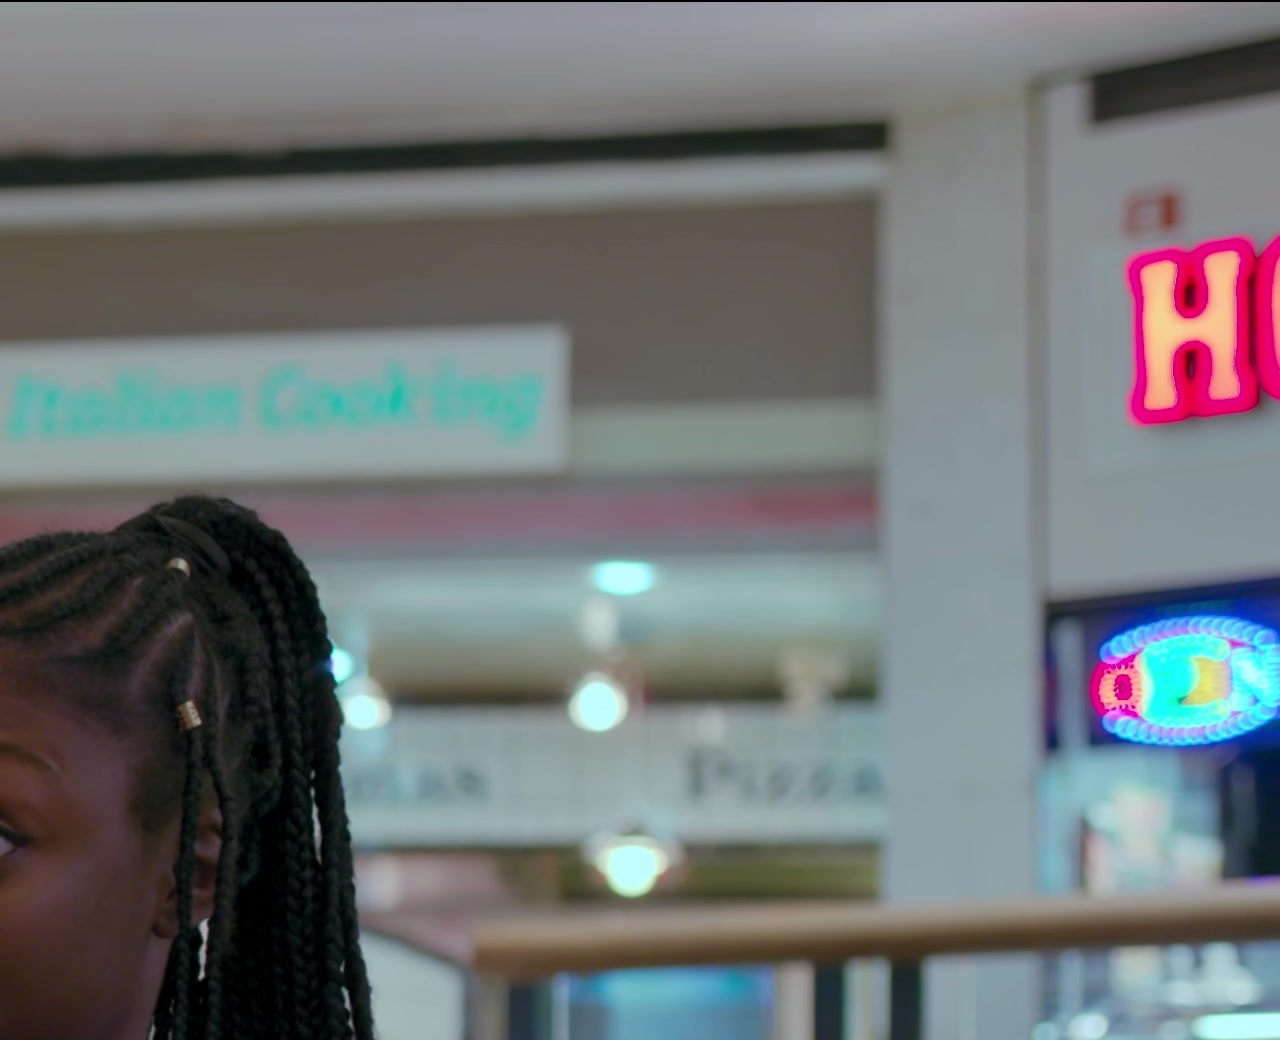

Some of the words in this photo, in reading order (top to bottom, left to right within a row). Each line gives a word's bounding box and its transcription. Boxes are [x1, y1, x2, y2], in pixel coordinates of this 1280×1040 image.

[1132, 236, 1280, 424] H
[7, 366, 241, 438] Italian
[256, 357, 544, 443] Cooking
